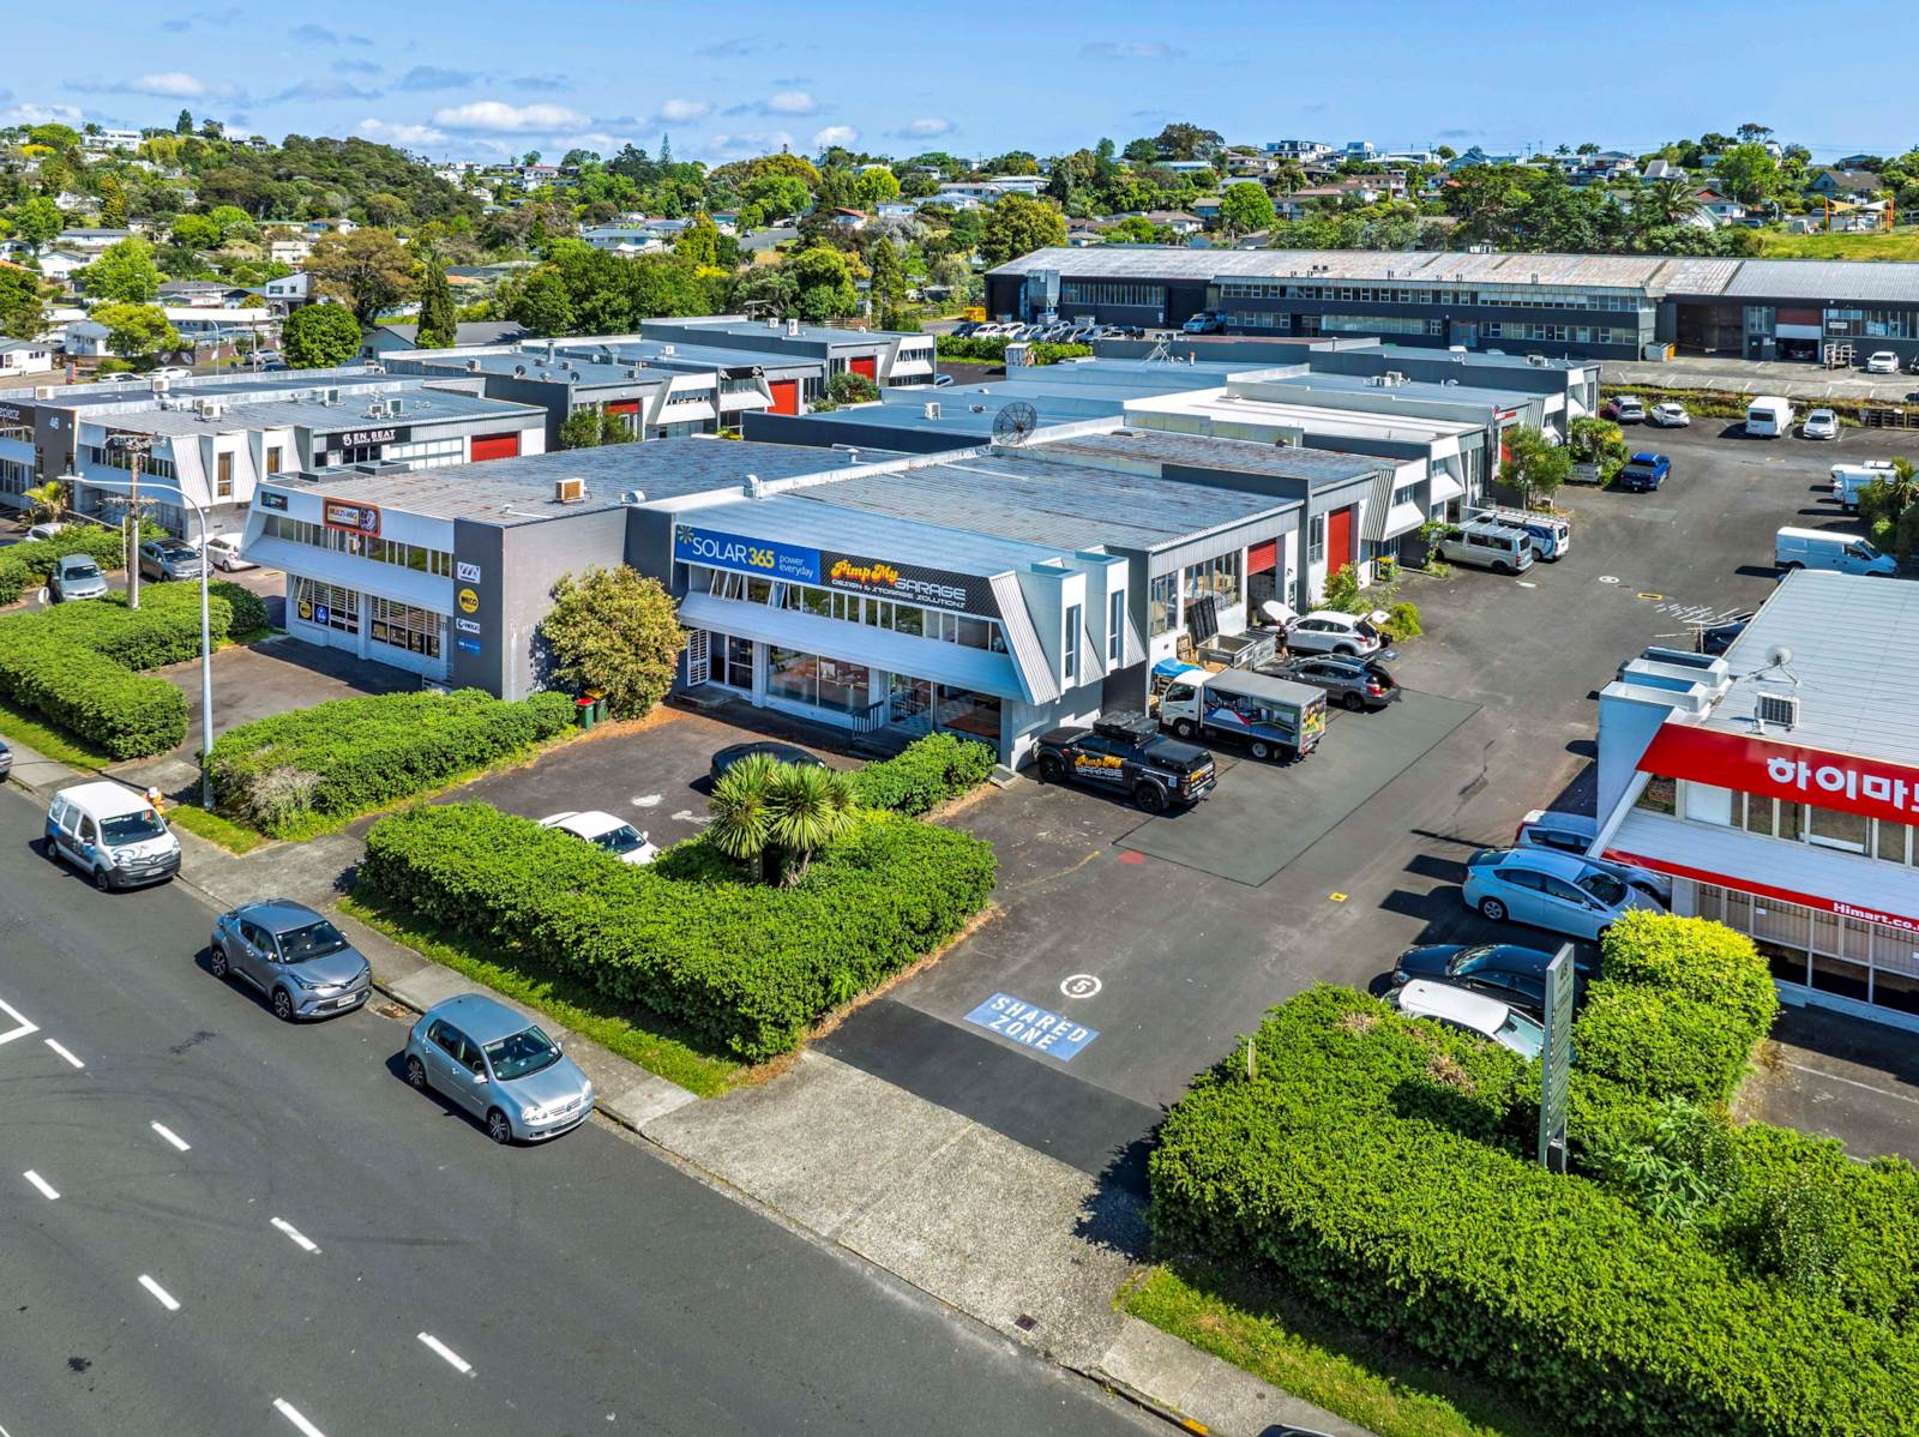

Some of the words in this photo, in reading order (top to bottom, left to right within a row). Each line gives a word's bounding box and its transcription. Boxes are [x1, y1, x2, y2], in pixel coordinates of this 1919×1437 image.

[692, 537, 747, 564] SOLAR
[748, 547, 775, 568] 365
[779, 555, 805, 566] power
[779, 563, 814, 578] everyday
[830, 559, 871, 584] Pimp
[871, 563, 899, 586] My
[895, 577, 966, 600] GARAGE
[1833, 902, 1919, 931] Himart.co.
[988, 1013, 1059, 1050] ZONE
[990, 997, 1089, 1042] SHARED
